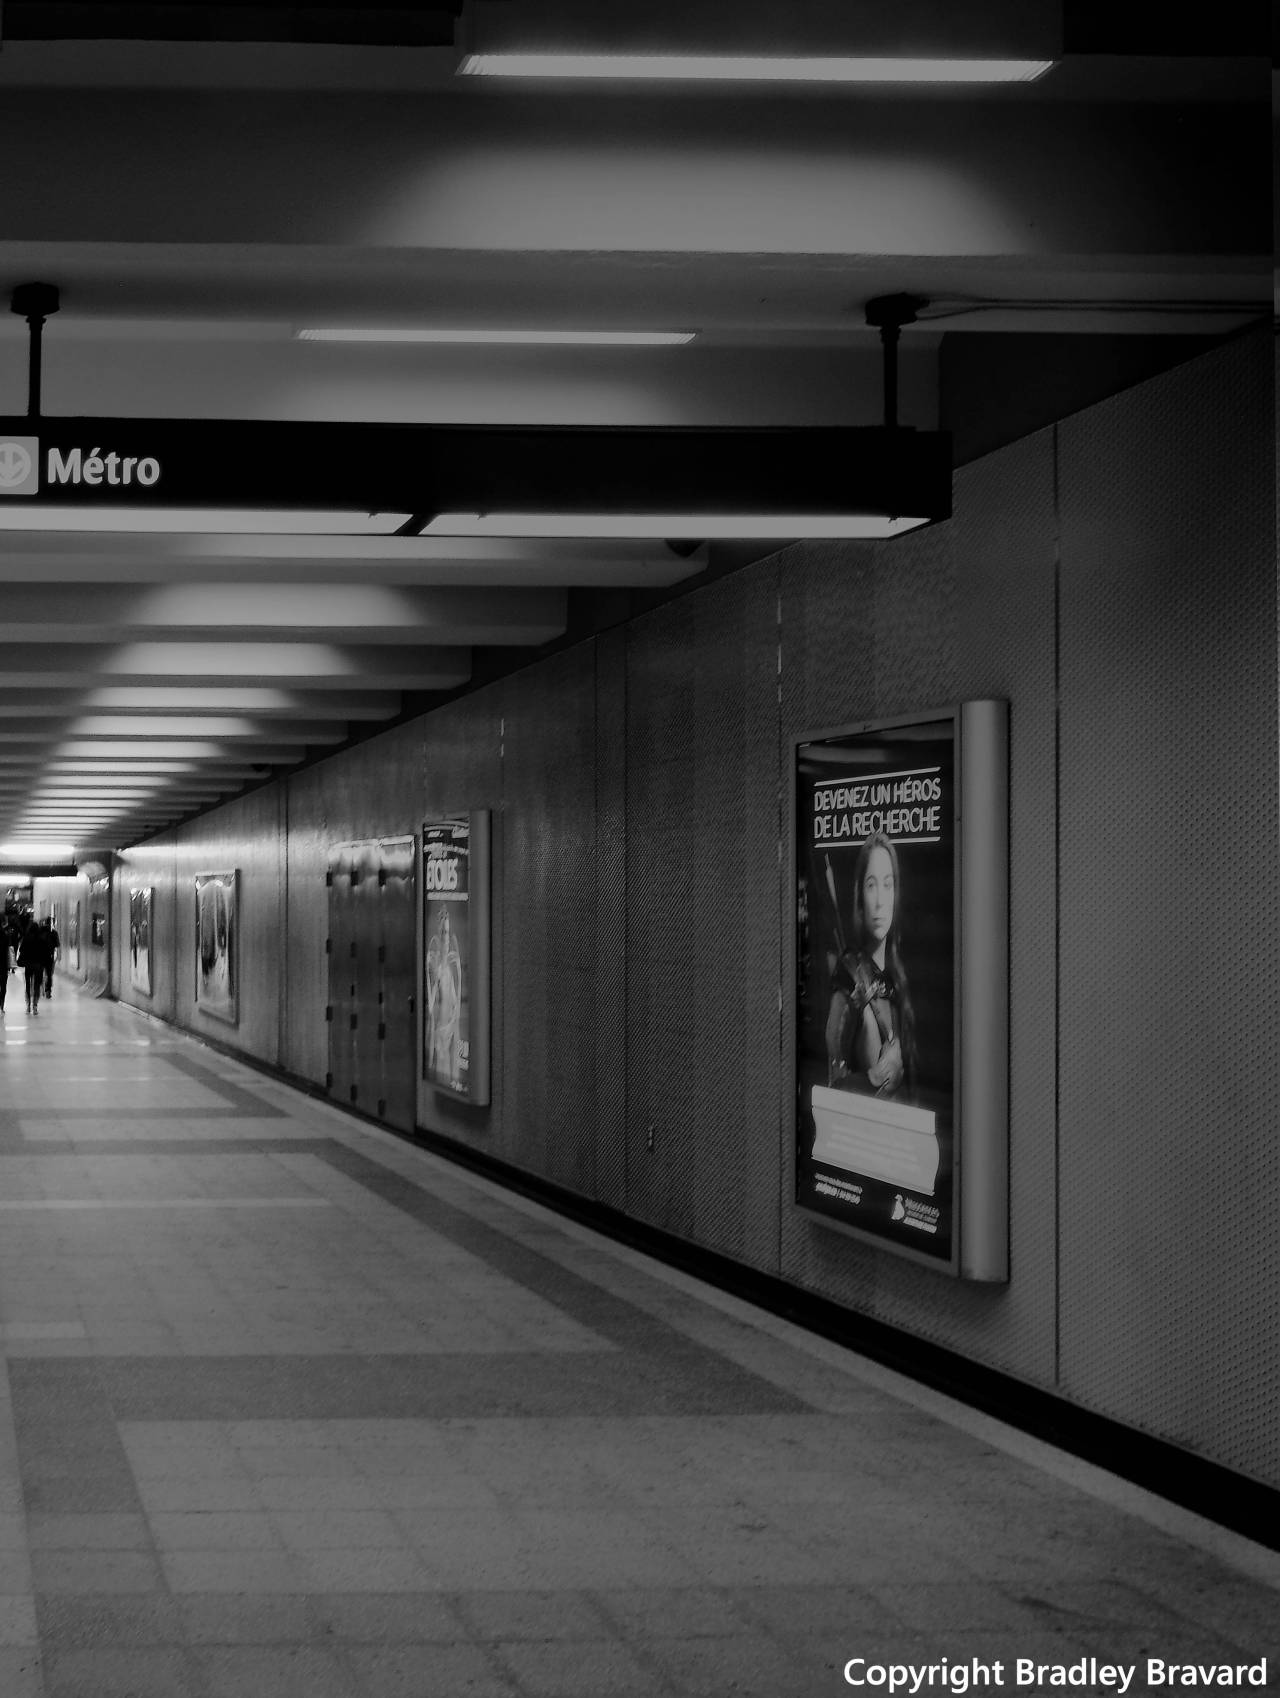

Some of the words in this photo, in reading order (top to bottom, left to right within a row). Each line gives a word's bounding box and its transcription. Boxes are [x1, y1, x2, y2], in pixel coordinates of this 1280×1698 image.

[48, 447, 160, 485] Métro
[814, 787, 869, 811] DEVENEZ
[871, 784, 891, 805] UN
[894, 777, 942, 804] HÉROS
[814, 815, 832, 838] DE
[833, 814, 850, 837] LA
[852, 807, 941, 837] RECHERCHE
